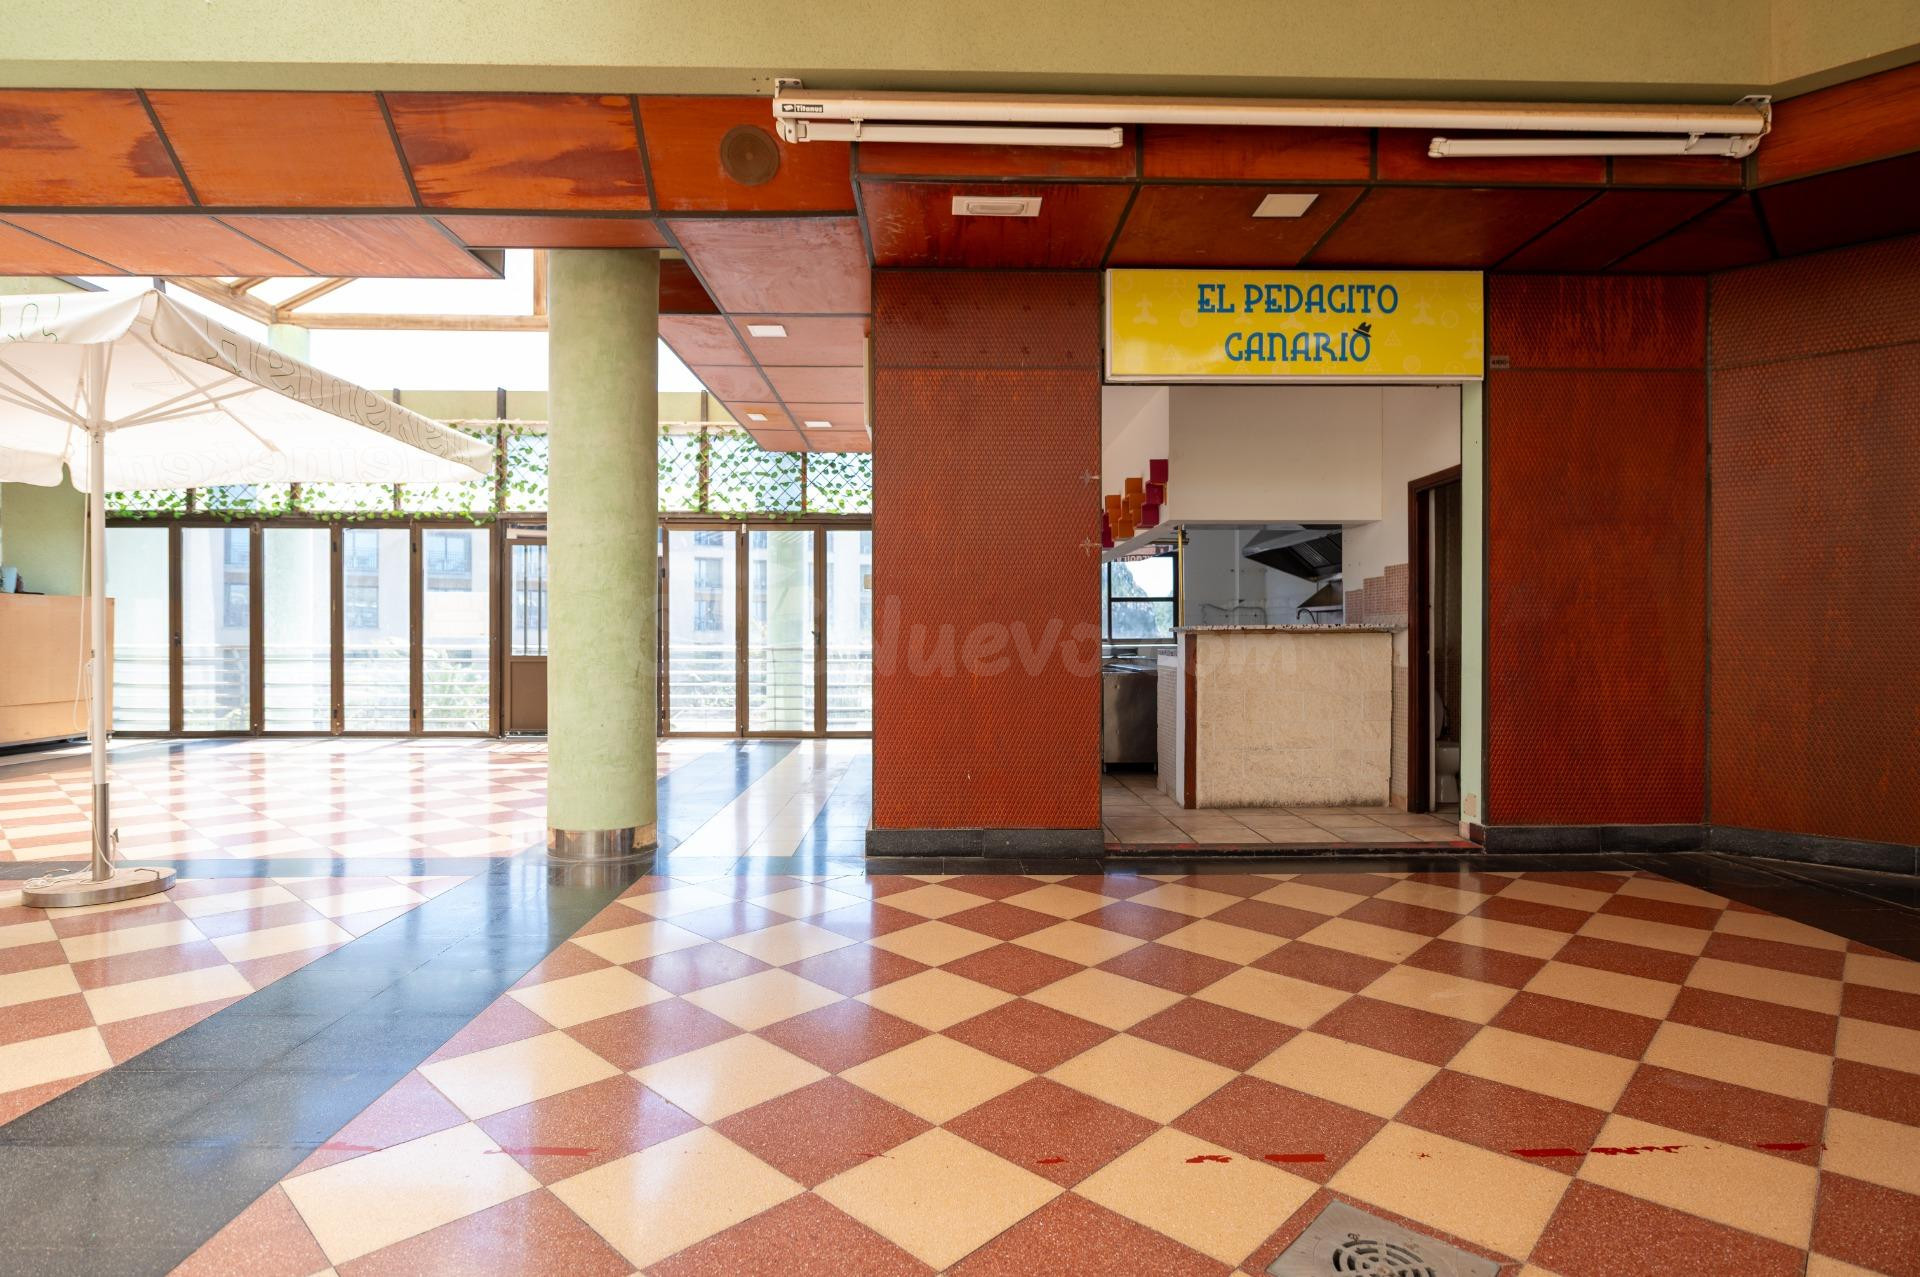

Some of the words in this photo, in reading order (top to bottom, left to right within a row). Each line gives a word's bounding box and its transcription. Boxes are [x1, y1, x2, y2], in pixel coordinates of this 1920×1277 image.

[1197, 284, 1235, 313] EL
[1244, 284, 1399, 313] PEDACITO
[1224, 331, 1371, 362] CANARIO
